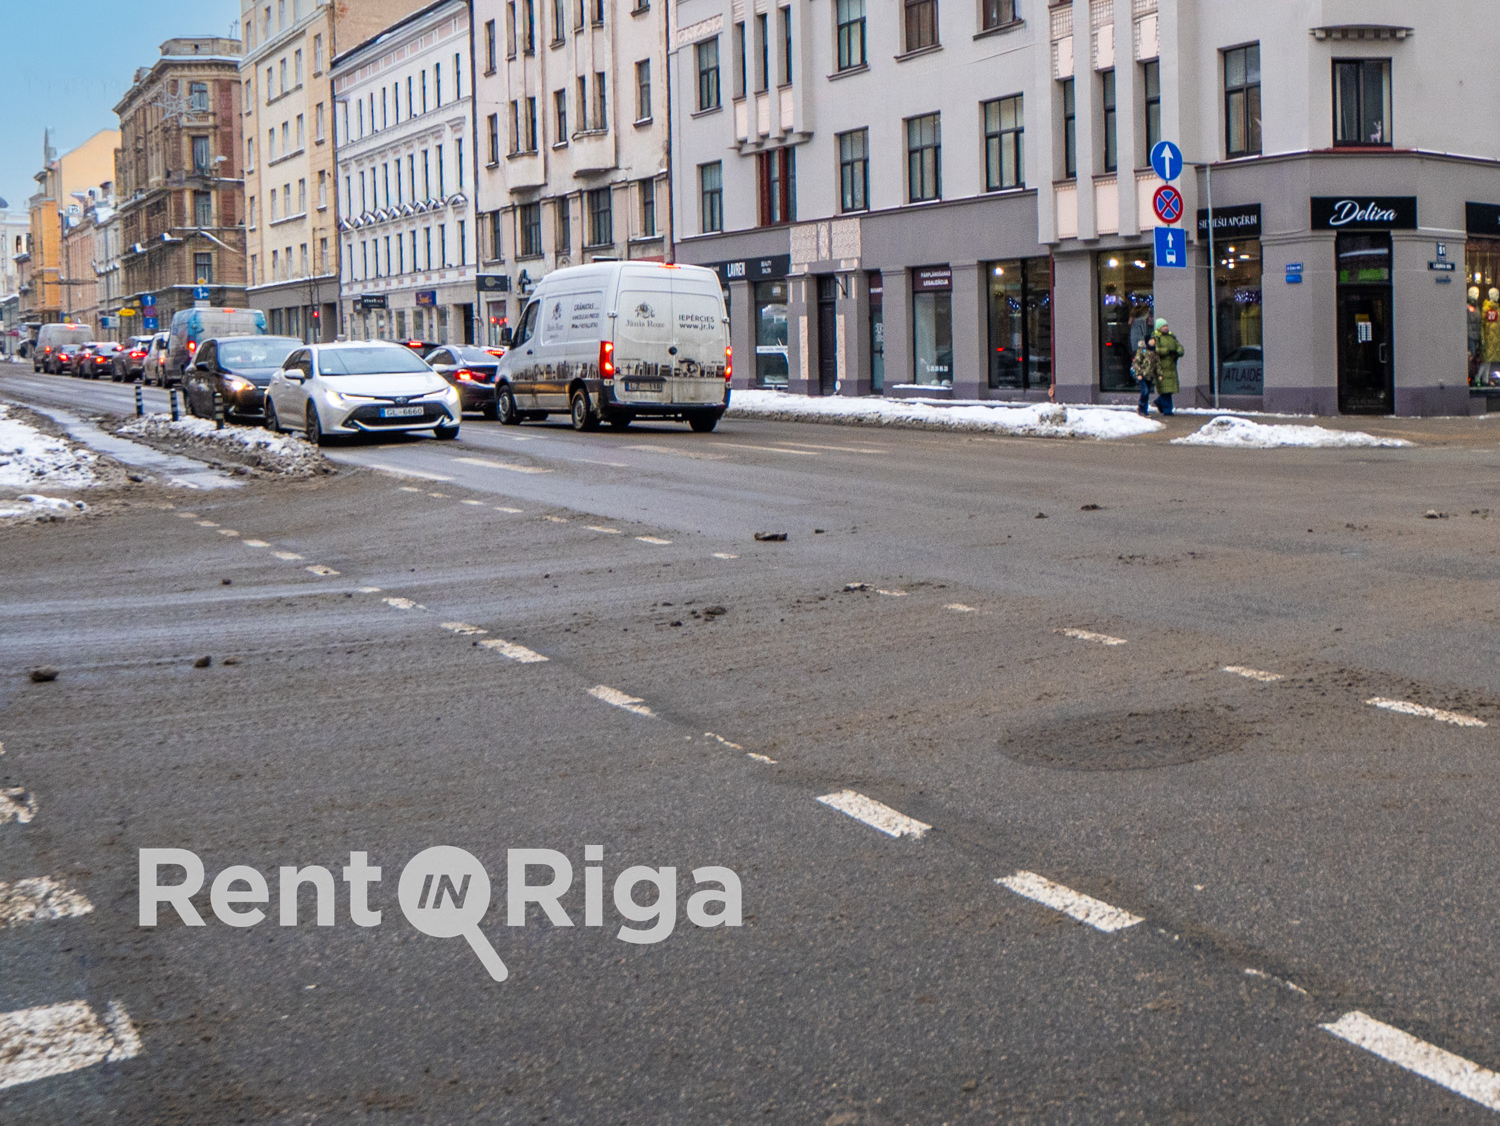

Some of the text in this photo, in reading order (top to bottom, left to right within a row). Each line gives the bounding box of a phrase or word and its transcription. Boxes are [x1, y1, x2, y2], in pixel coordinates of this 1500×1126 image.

[1329, 200, 1398, 226] Deliza
[678, 314, 715, 323] IEPĒRCIES
[647, 320, 665, 329] Roze
[679, 322, 715, 331] www.jr.lv
